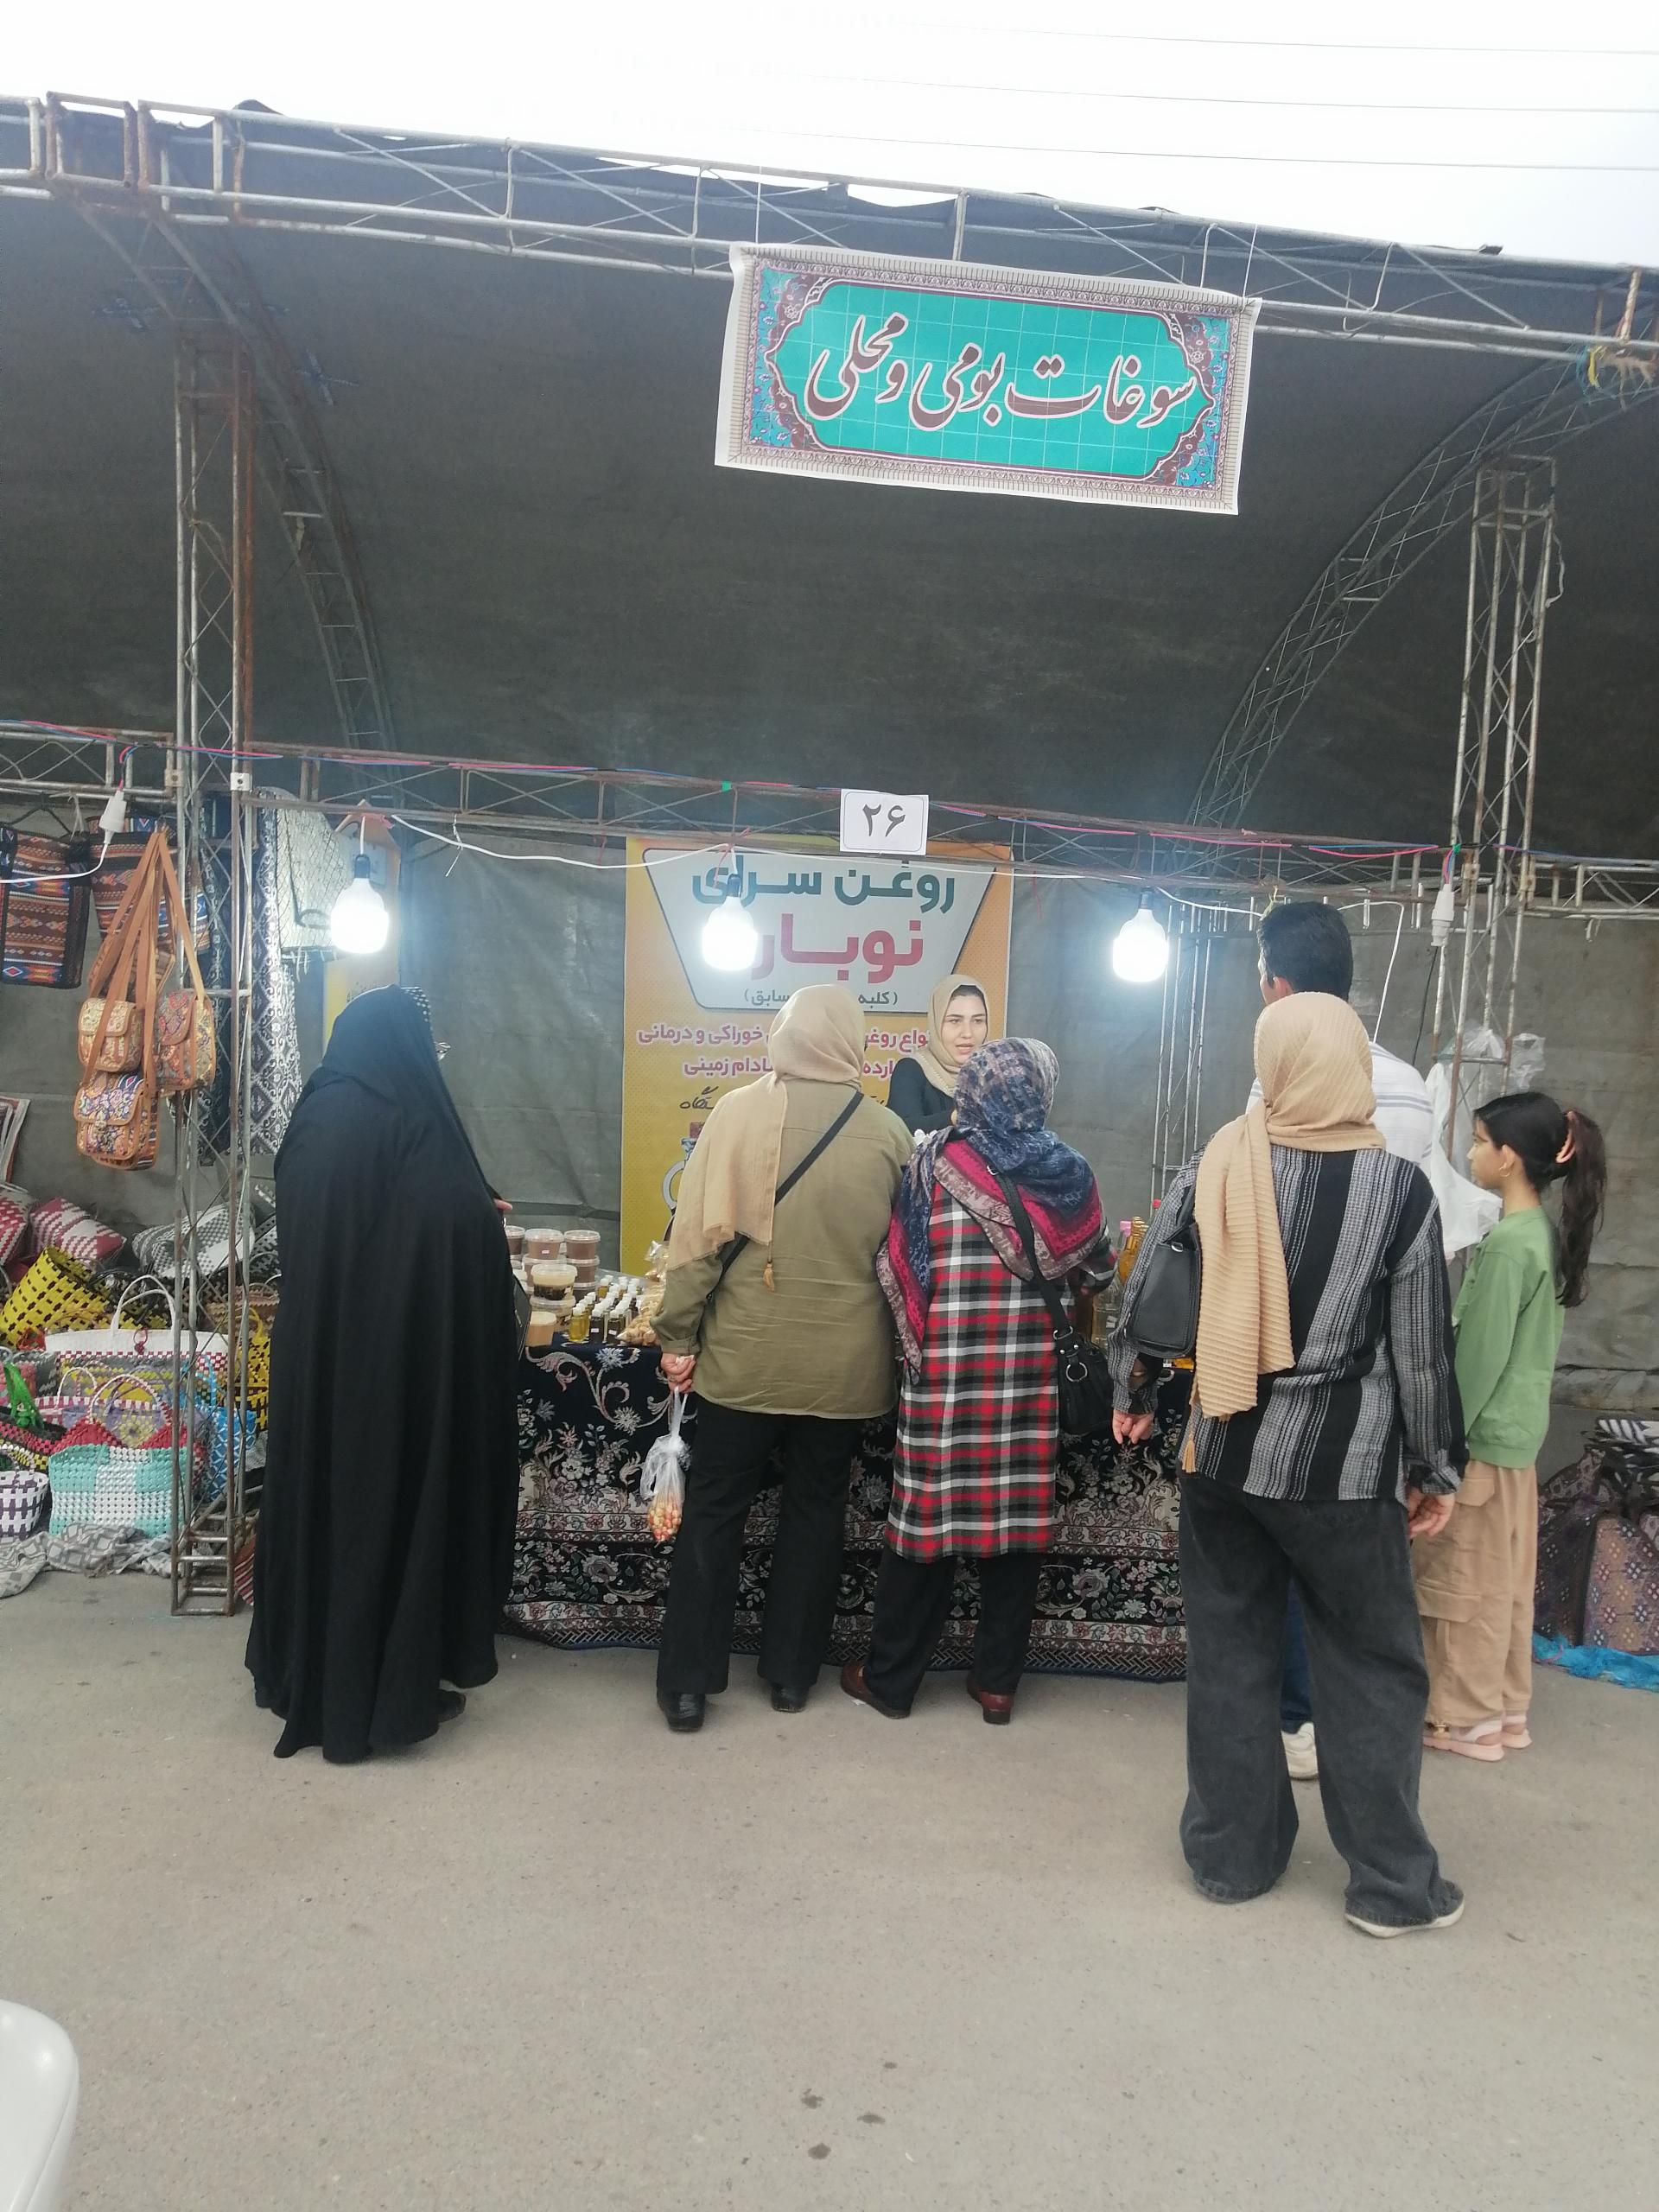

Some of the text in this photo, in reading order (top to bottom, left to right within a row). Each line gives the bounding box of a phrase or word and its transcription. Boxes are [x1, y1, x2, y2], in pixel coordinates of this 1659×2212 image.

[804, 312, 1198, 432] سوغات بومی و محلی
[862, 804, 906, 837] ۲۶
[692, 855, 956, 914] روغن سرای
[750, 912, 924, 984] نوبار
[638, 1023, 692, 1044] درمانی
[696, 1029, 706, 1045] و
[709, 1025, 763, 1046] خوراکی
[863, 1028, 897, 1052] روغ
[683, 1058, 729, 1077] زمینی
